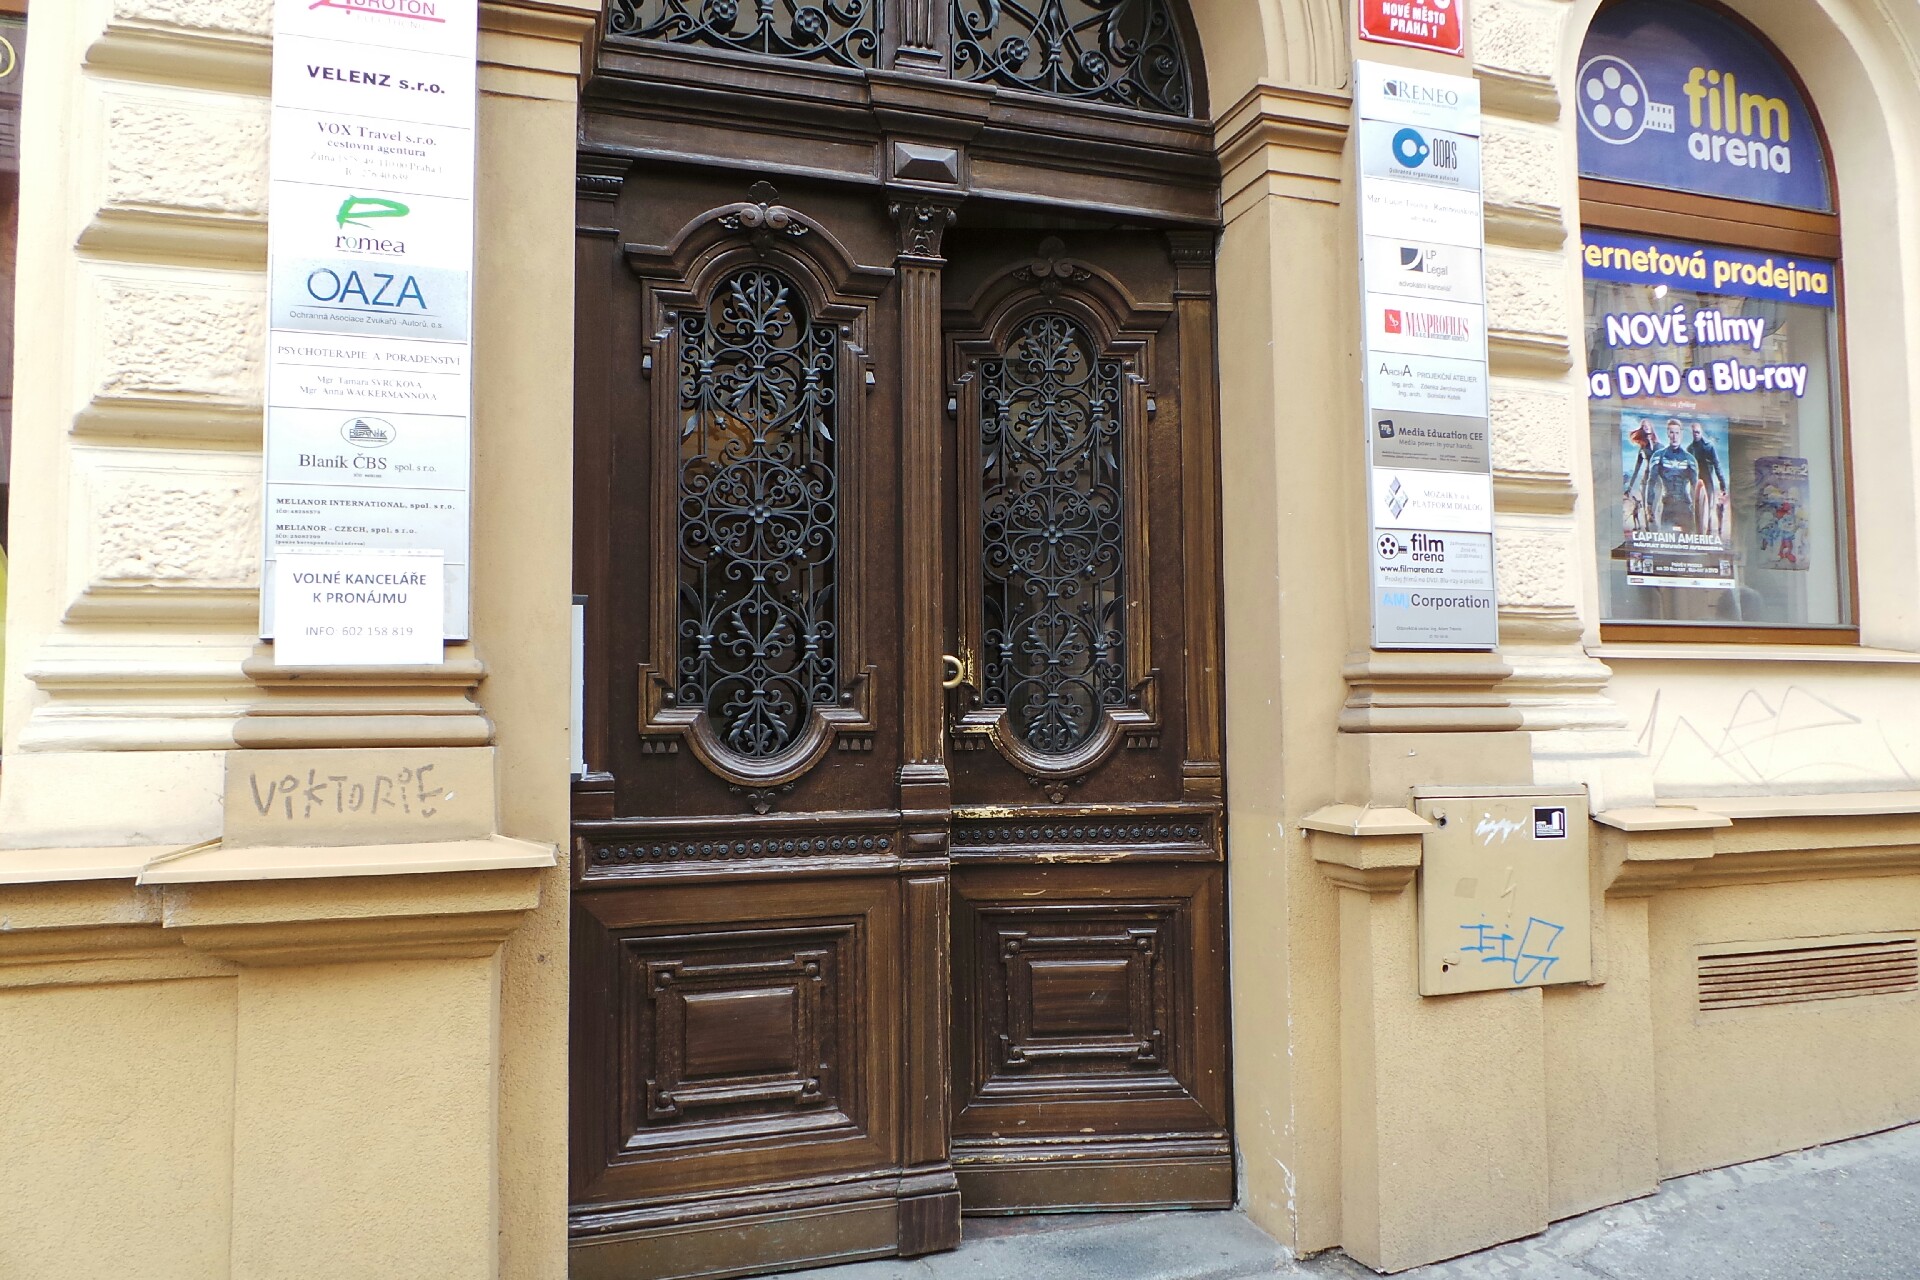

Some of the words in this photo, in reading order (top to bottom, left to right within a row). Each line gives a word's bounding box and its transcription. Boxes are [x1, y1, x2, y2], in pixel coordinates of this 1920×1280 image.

[1382, 2, 1410, 18] NOVÉ
[1412, 6, 1446, 26] MĚSTO
[1390, 18, 1428, 36] PRAHA
[1431, 25, 1438, 39] 1
[307, 65, 391, 87] VELENZ
[399, 79, 445, 94] s.r.o.
[1399, 80, 1458, 105] RENEO
[1683, 66, 1789, 143] film
[317, 121, 351, 136] VOX
[356, 125, 401, 142] Travel
[405, 135, 437, 146] s.r.o.
[377, 145, 426, 157] agentura
[1687, 131, 1791, 174] arena
[334, 235, 406, 253] romea
[1425, 249, 1437, 260] LP
[1426, 263, 1448, 277] Legal
[1713, 258, 1828, 298] prodejna
[307, 268, 427, 309] OAZA
[289, 310, 328, 322] Ochranná
[329, 313, 364, 324] Asociace
[366, 315, 397, 326] Zvukařů
[1605, 304, 1689, 347] NOVÉ
[1693, 309, 1765, 350] filmy
[277, 346, 367, 360] PSYCHOTERAPIE
[1417, 371, 1452, 381] PROJEKČNÍ
[1452, 374, 1477, 383] ATELIER
[1617, 363, 1681, 396] DVD
[1687, 367, 1707, 393] a
[1711, 359, 1808, 397] Blu-ray
[323, 388, 344, 396] Anna
[1398, 427, 1426, 437] Media
[1427, 429, 1468, 441] Education
[1469, 432, 1483, 441] CEE
[1442, 442, 1456, 450] your
[298, 453, 349, 469] Blaník
[353, 453, 387, 470] ČBS
[394, 463, 415, 473] spol.
[423, 465, 437, 473] r.o.
[276, 498, 327, 506] MELIANOR
[410, 502, 432, 510] spol.
[1412, 500, 1453, 509] PLATFORM
[275, 524, 327, 532] MELIANOR
[334, 525, 369, 534] CZECH,
[370, 527, 393, 535] spol.
[1410, 533, 1444, 552] film
[1632, 531, 1676, 543] CAPTAIN
[1677, 533, 1723, 545] AMERICA
[1411, 552, 1445, 562] arena
[1379, 564, 1444, 574] www.filmarena.cz
[292, 571, 340, 584] VOLNÉ
[345, 571, 427, 586] KANCELÁŘE
[313, 592, 321, 603] K
[326, 590, 407, 604] PRONÁJMU
[1411, 593, 1490, 610] Corporation
[342, 626, 362, 636] 602
[368, 626, 388, 636] 158
[391, 626, 413, 636] 819
